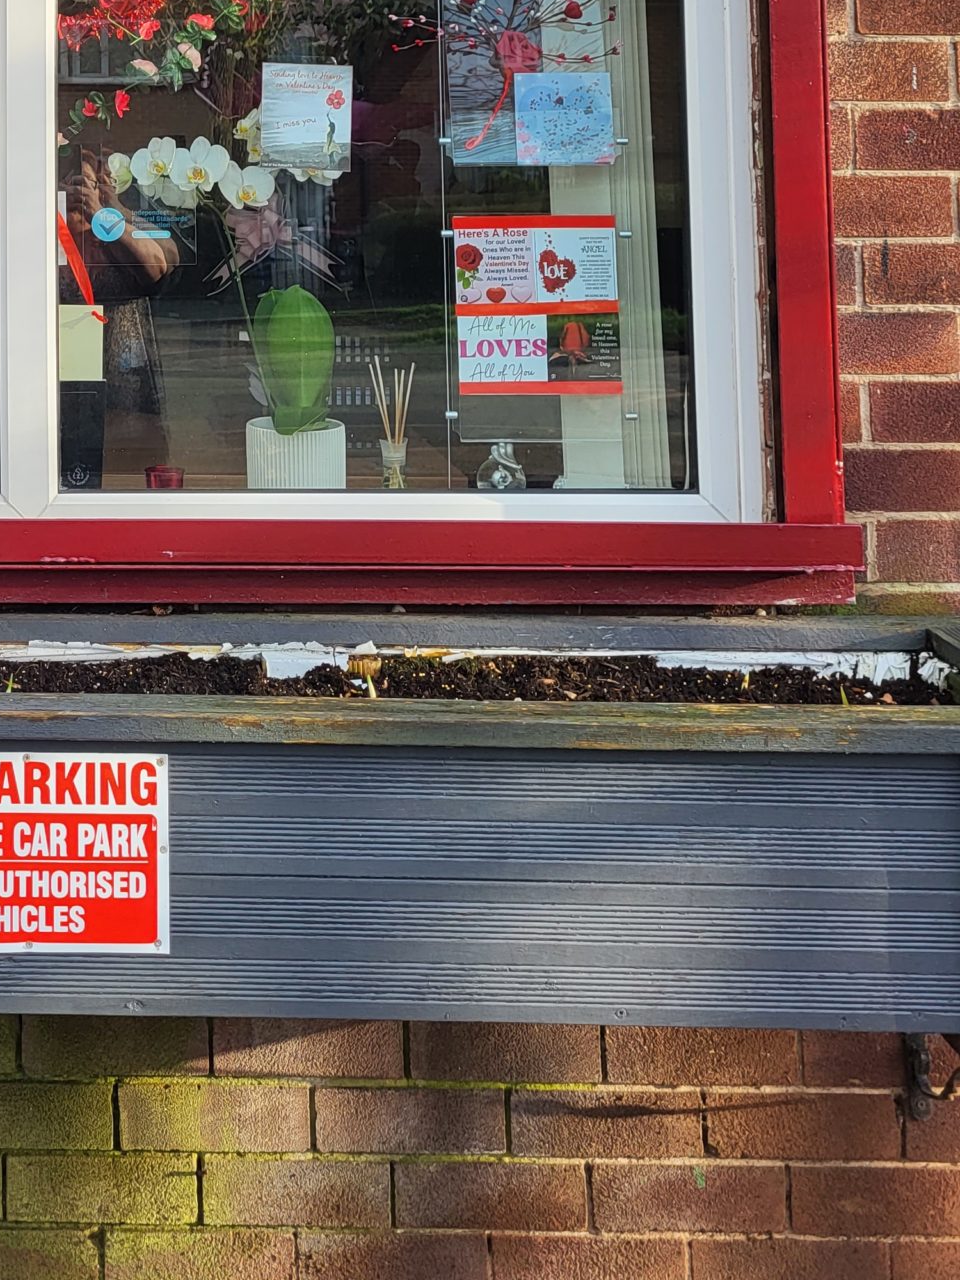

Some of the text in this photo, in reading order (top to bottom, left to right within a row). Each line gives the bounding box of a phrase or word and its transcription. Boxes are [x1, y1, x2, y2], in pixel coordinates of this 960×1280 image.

[271, 70, 296, 80] Sending
[298, 70, 310, 78] love
[285, 82, 320, 90] Valentine's
[322, 82, 336, 91] Day
[275, 122, 281, 130] I
[302, 118, 317, 128] you
[458, 228, 528, 238] Here's A Rose
[542, 262, 568, 280] LOVE
[468, 315, 536, 337] All of Me
[459, 338, 548, 358] LOVES
[469, 362, 535, 382] All of You
[13, 822, 68, 857] CAR
[78, 823, 148, 858] PARK
